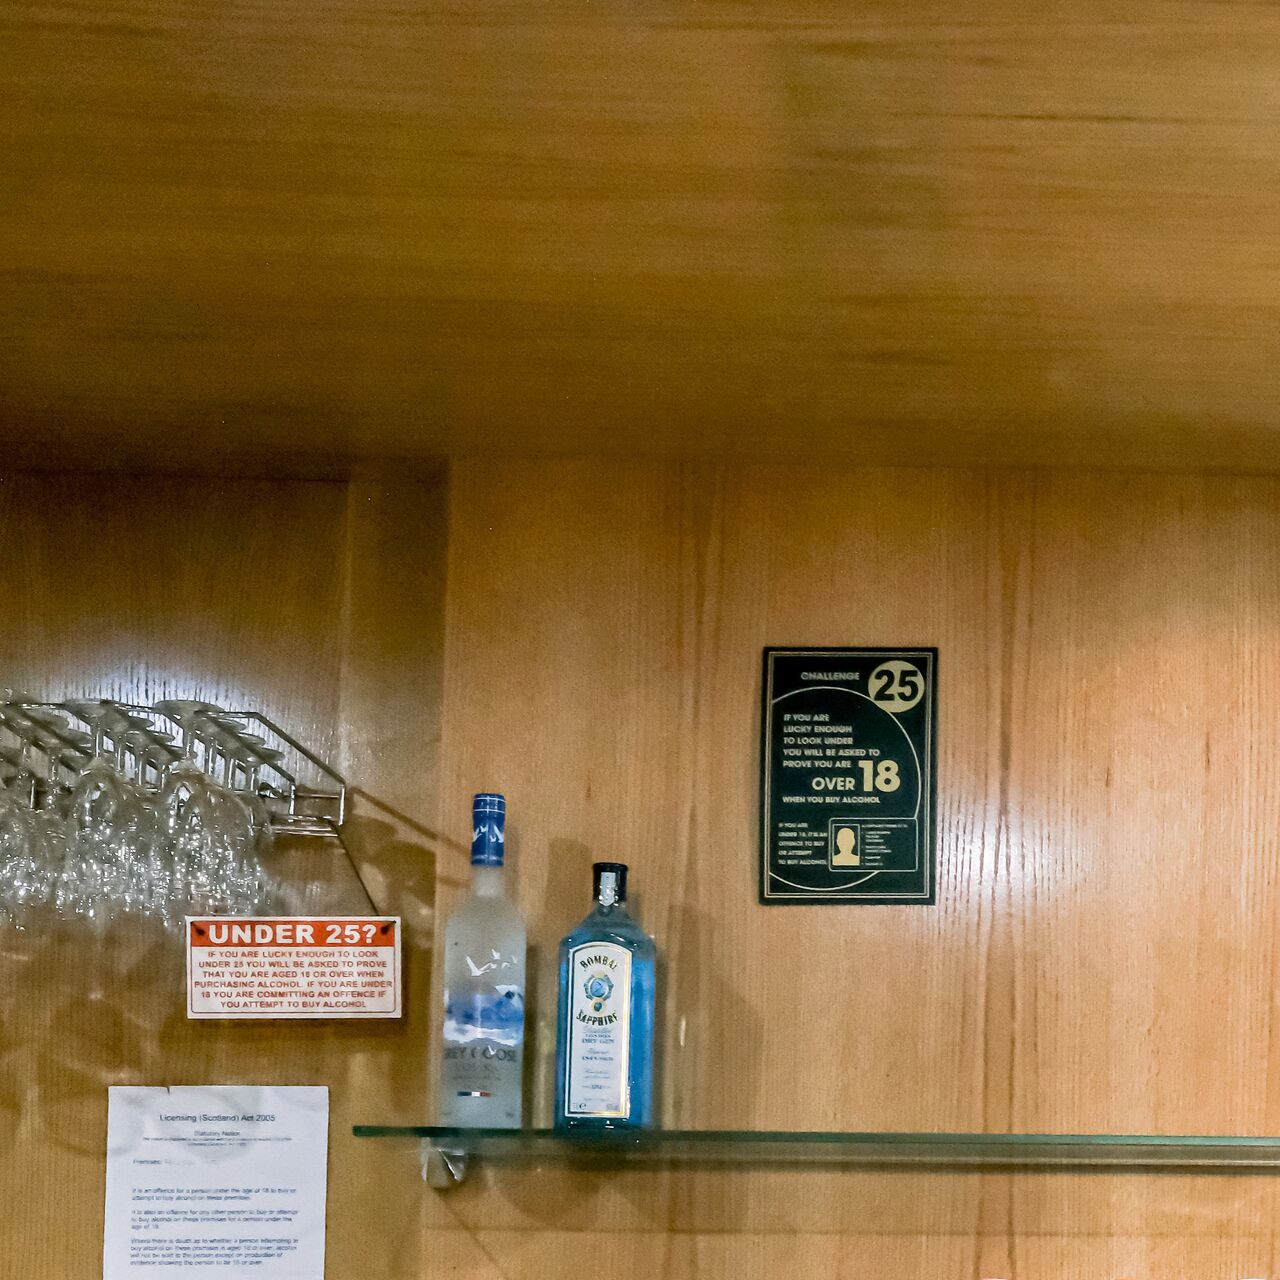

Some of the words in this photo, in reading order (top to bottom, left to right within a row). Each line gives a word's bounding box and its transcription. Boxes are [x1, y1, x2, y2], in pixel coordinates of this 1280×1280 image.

[801, 672, 859, 680] CHALLENGE
[874, 670, 918, 701] 25
[812, 778, 855, 790] OVER
[858, 760, 900, 792] 18
[208, 924, 314, 944] UNDER
[326, 924, 376, 944] 25?
[160, 1114, 197, 1123] Licensing
[199, 1114, 239, 1123] (Scotland)
[241, 1114, 254, 1123] Act
[256, 1114, 275, 1123] 2005
